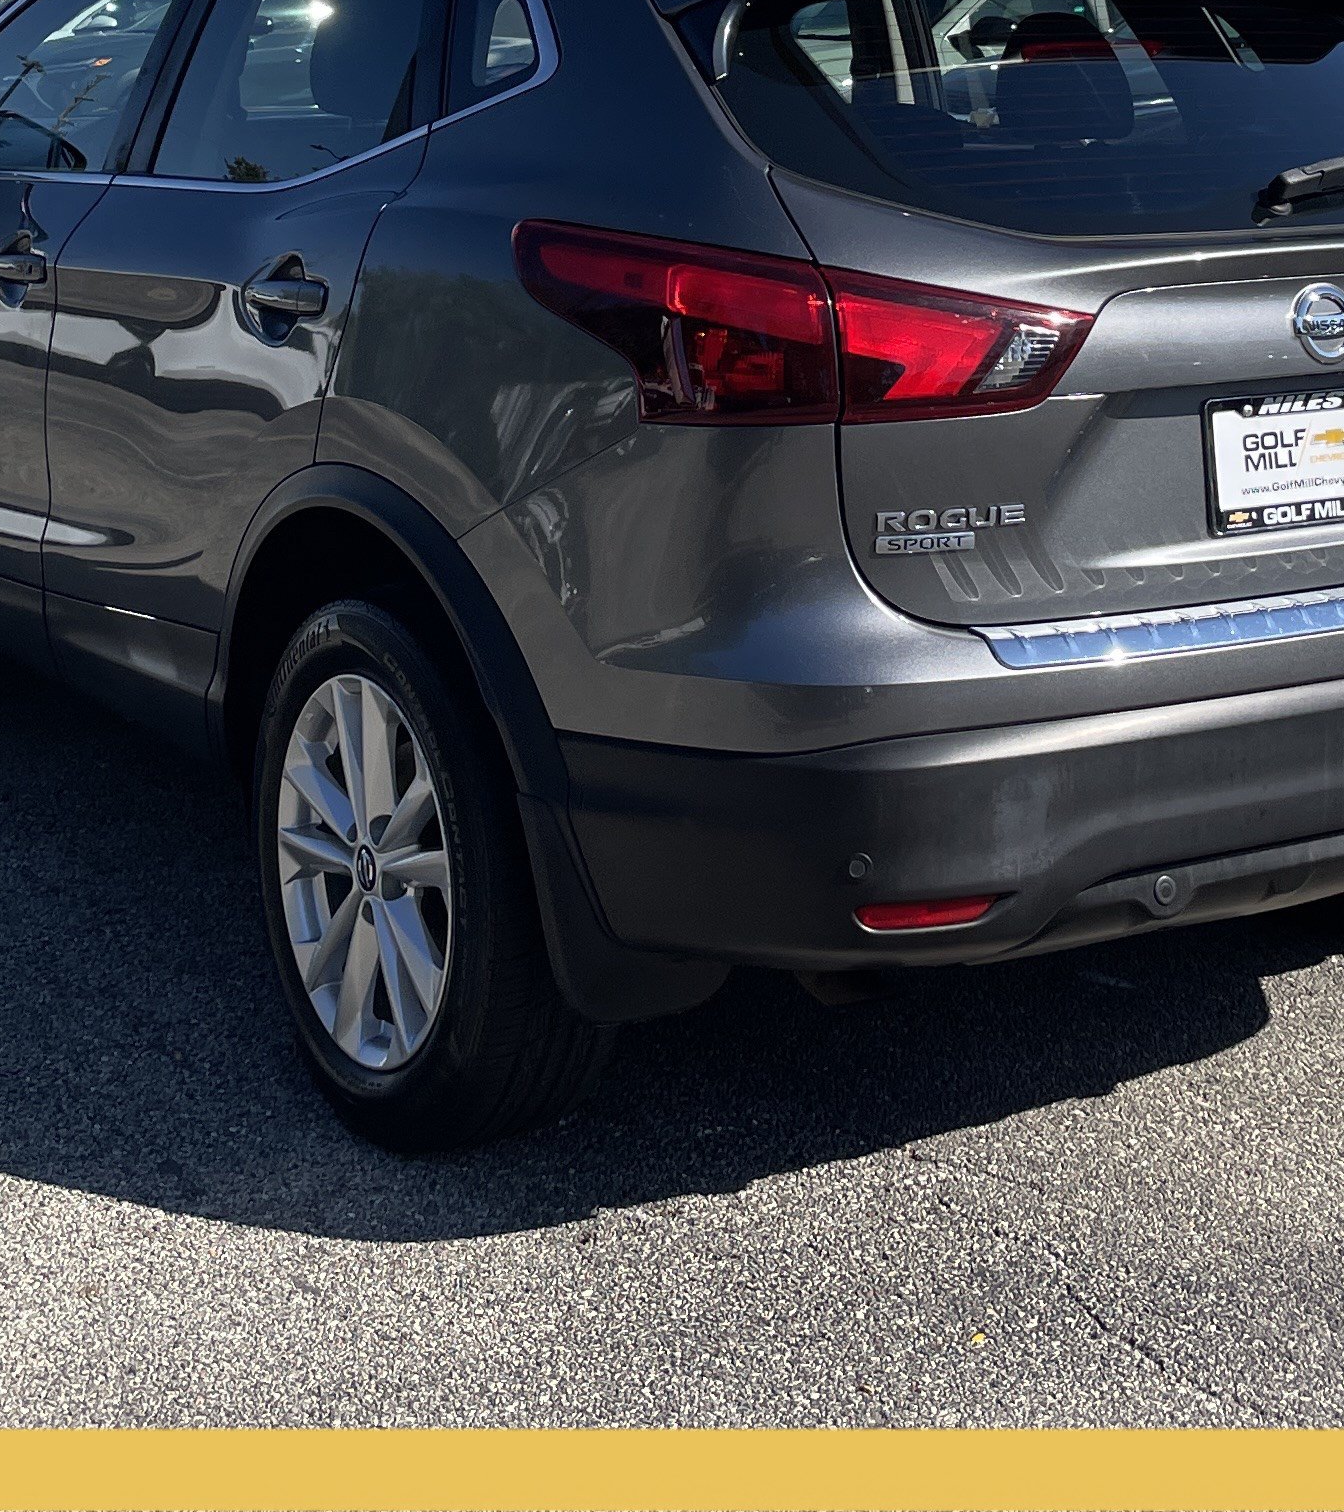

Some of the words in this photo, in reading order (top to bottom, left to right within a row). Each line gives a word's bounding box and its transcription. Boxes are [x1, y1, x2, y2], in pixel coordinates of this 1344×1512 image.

[1258, 391, 1344, 415] NILES
[1242, 428, 1306, 452] GOLF
[1244, 449, 1297, 473] MILL
[876, 503, 1026, 533] ROGUE
[1263, 503, 1312, 525] GOLF
[887, 536, 964, 552] SPORT
